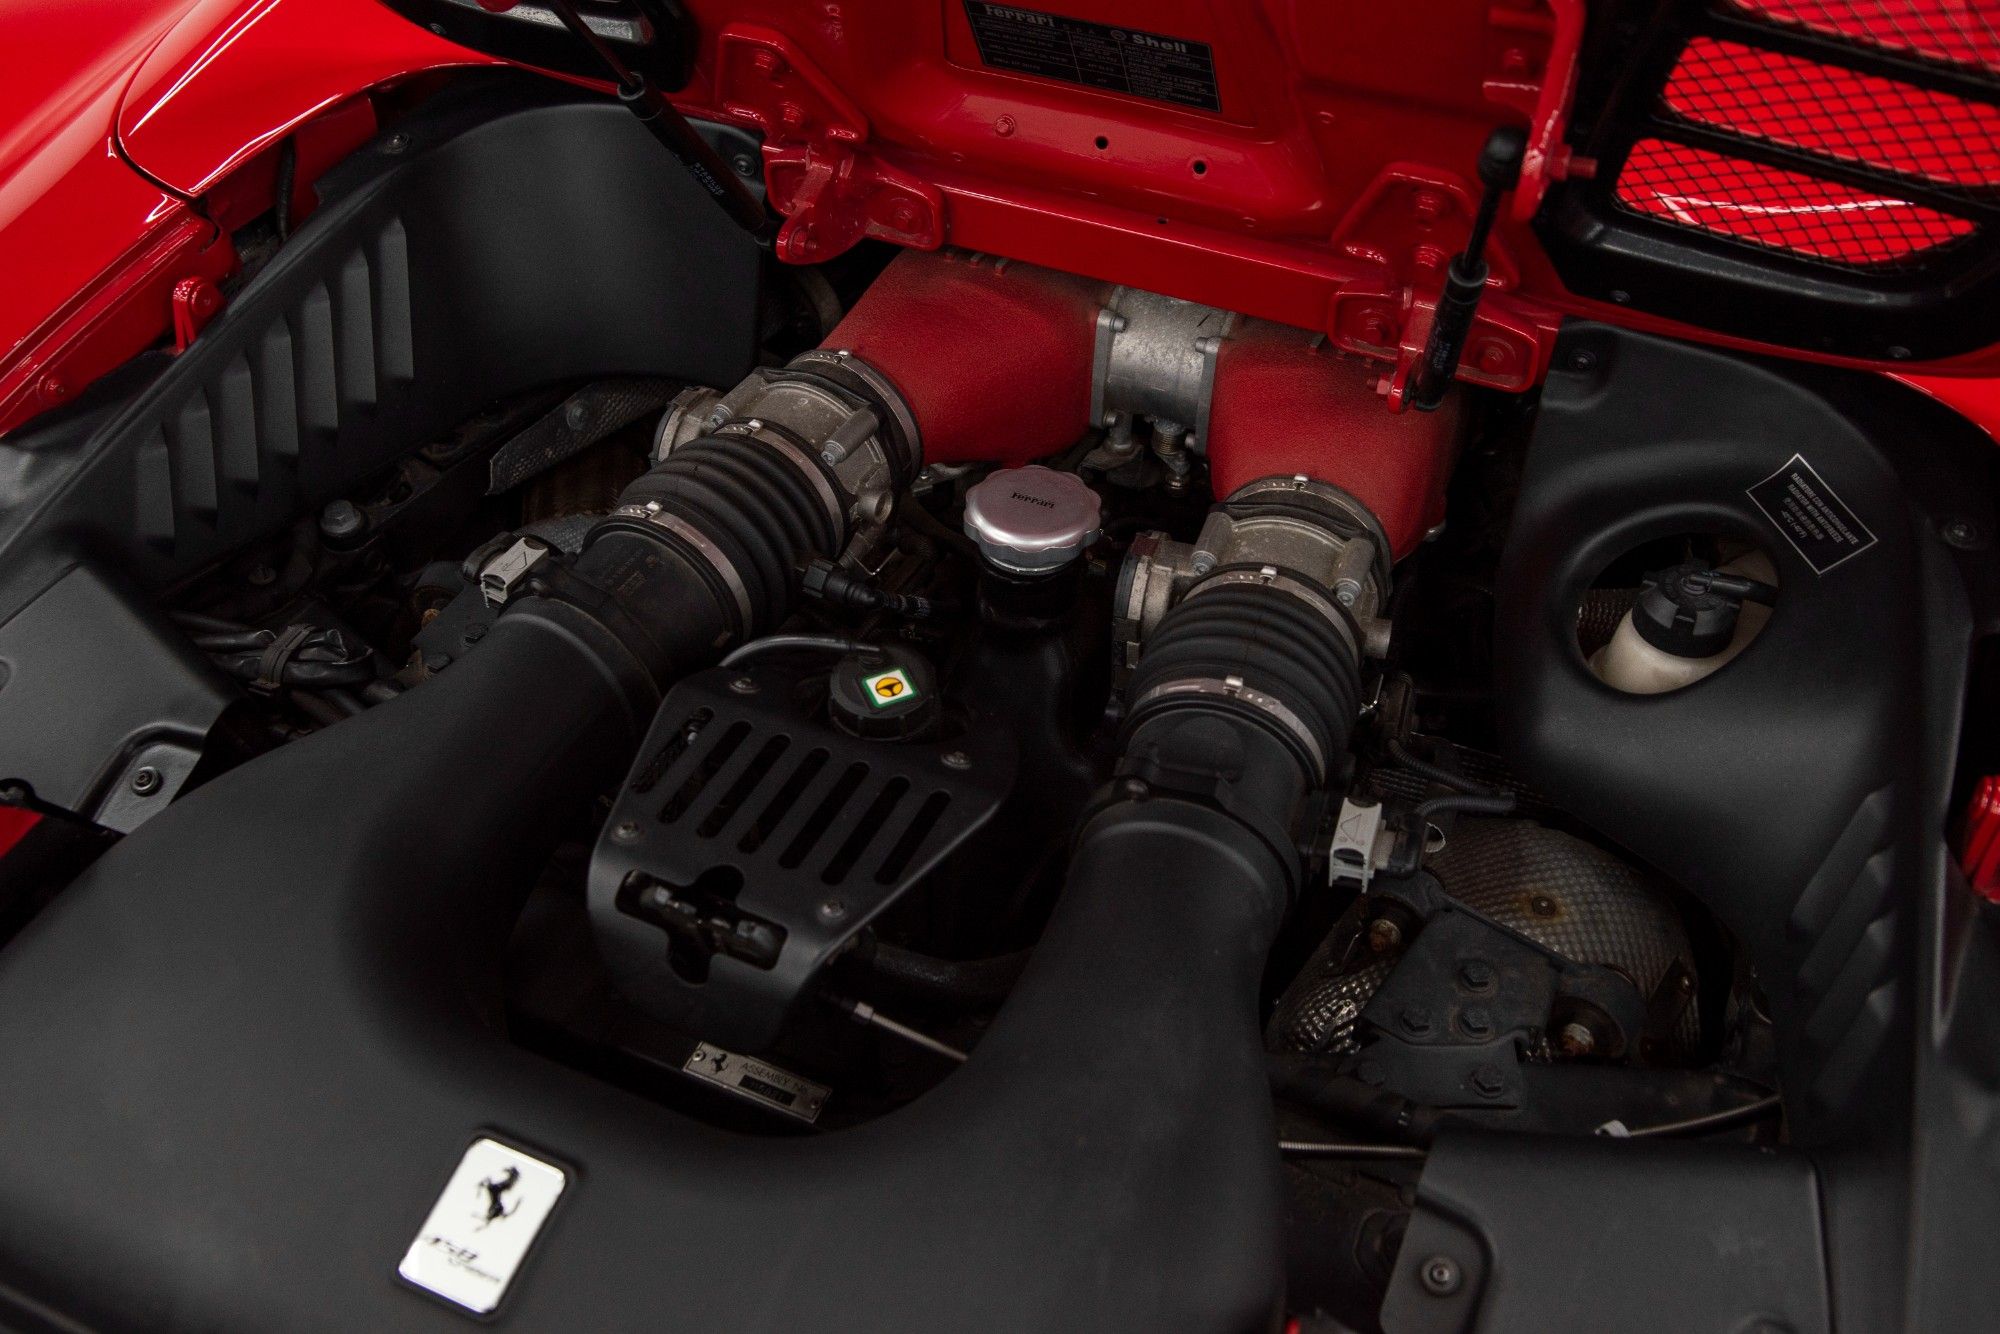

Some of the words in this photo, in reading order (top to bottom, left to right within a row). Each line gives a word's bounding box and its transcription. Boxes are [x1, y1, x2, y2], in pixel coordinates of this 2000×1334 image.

[985, 4, 1055, 27] Ferrari
[1132, 34, 1187, 53] Shell
[1011, 492, 1055, 509] Ferrari
[741, 1062, 791, 1088] ASSEMBLY
